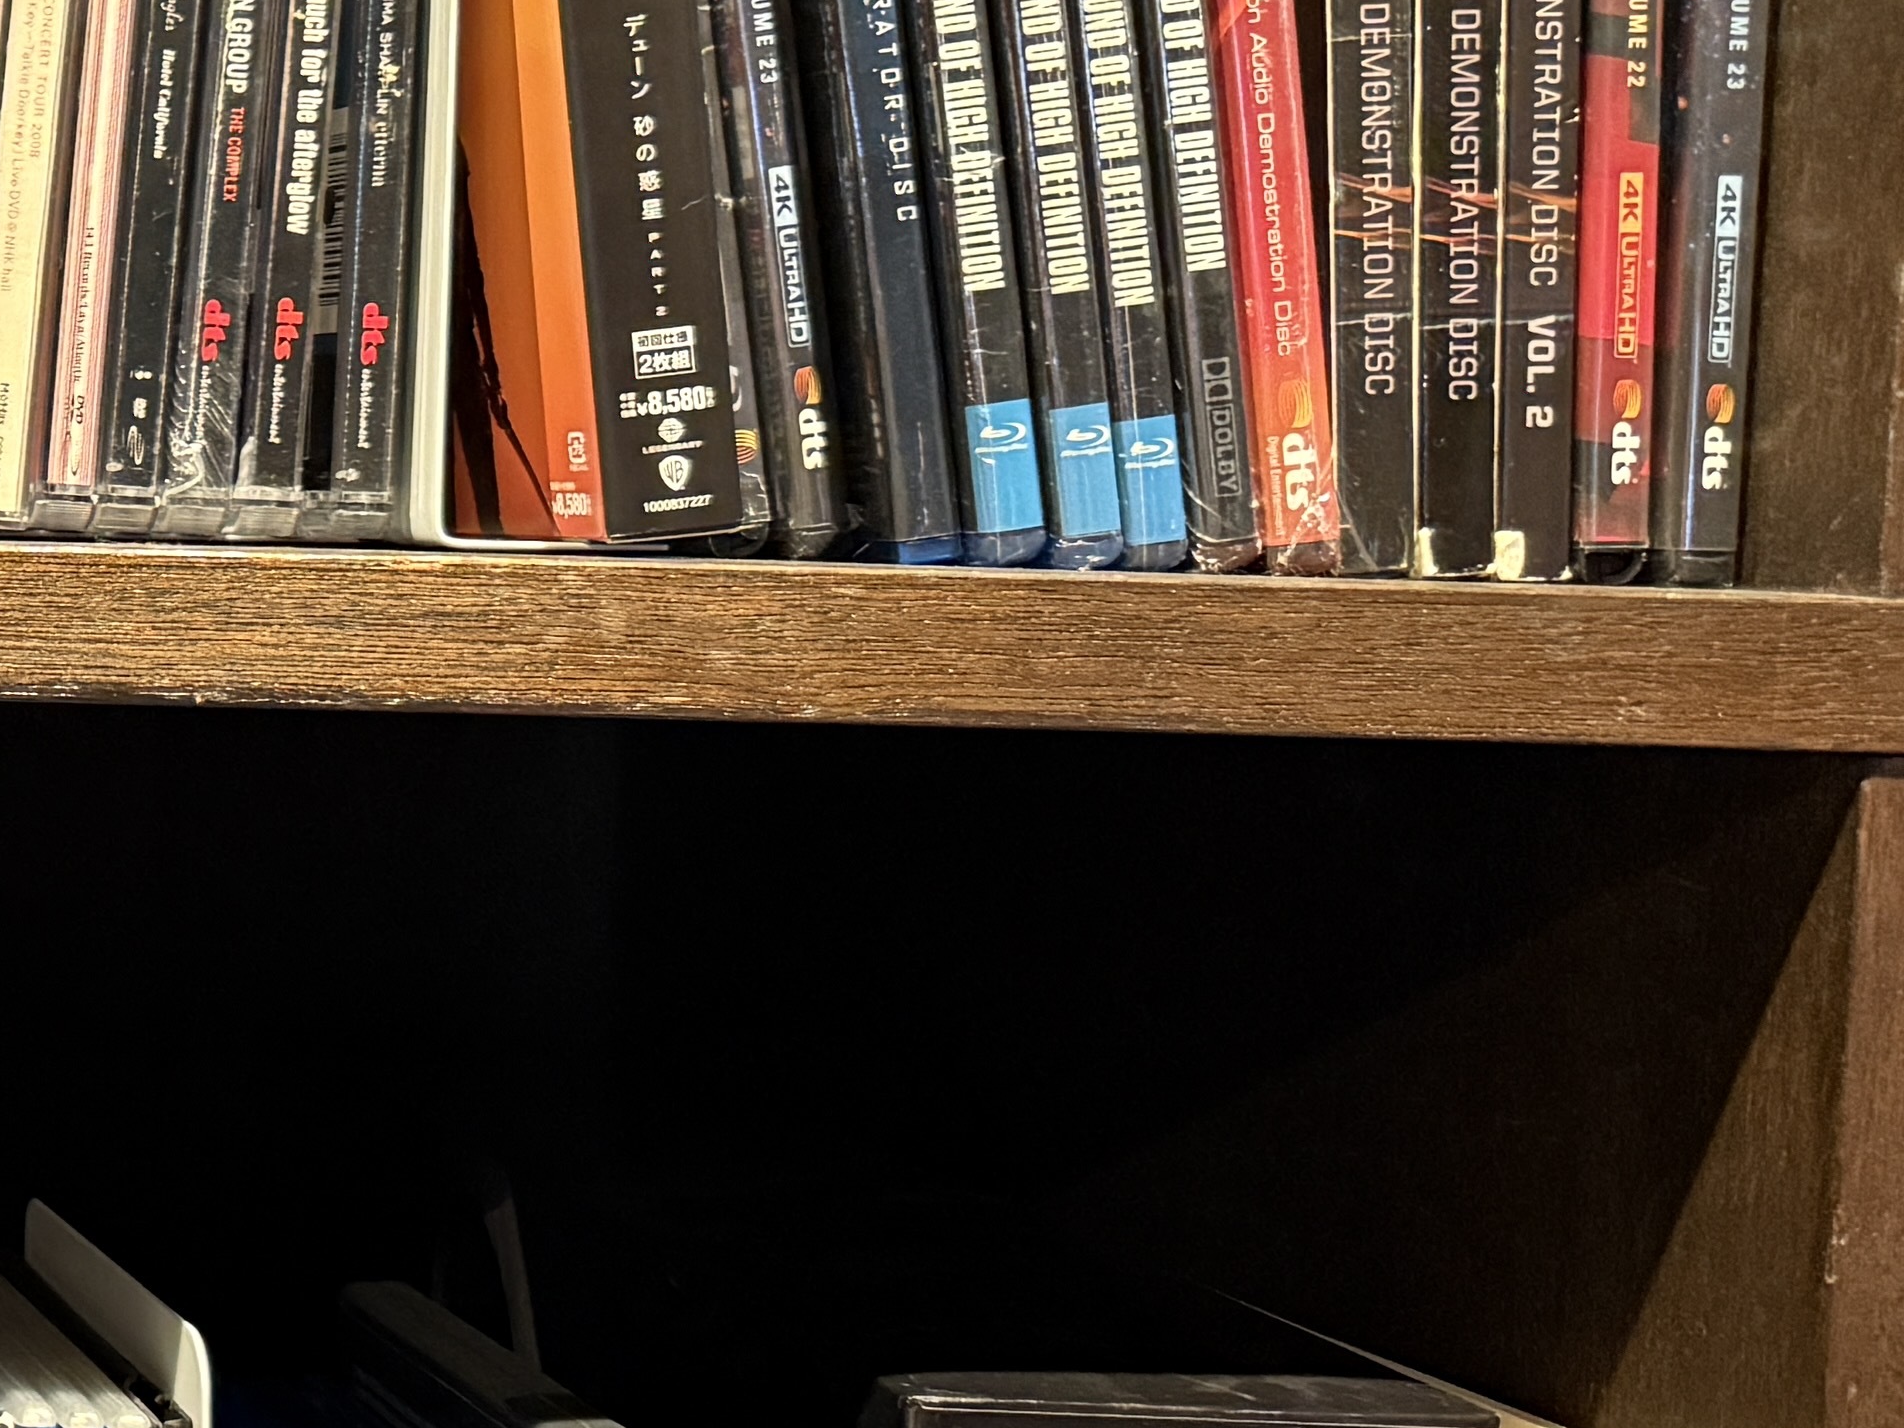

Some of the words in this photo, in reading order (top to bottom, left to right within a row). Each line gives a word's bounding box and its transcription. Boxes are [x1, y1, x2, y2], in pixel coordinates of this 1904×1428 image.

[224, 15, 255, 94] GROUP
[756, 53, 777, 84] 23
[941, 39, 982, 72] OF
[944, 77, 989, 146] HIGH
[951, 150, 1005, 292] DEFINITION
[1528, 204, 1559, 288] DISC
[1526, 315, 1557, 394] VOL.
[1525, 405, 1554, 430] 2
[1610, 422, 1640, 485] dts
